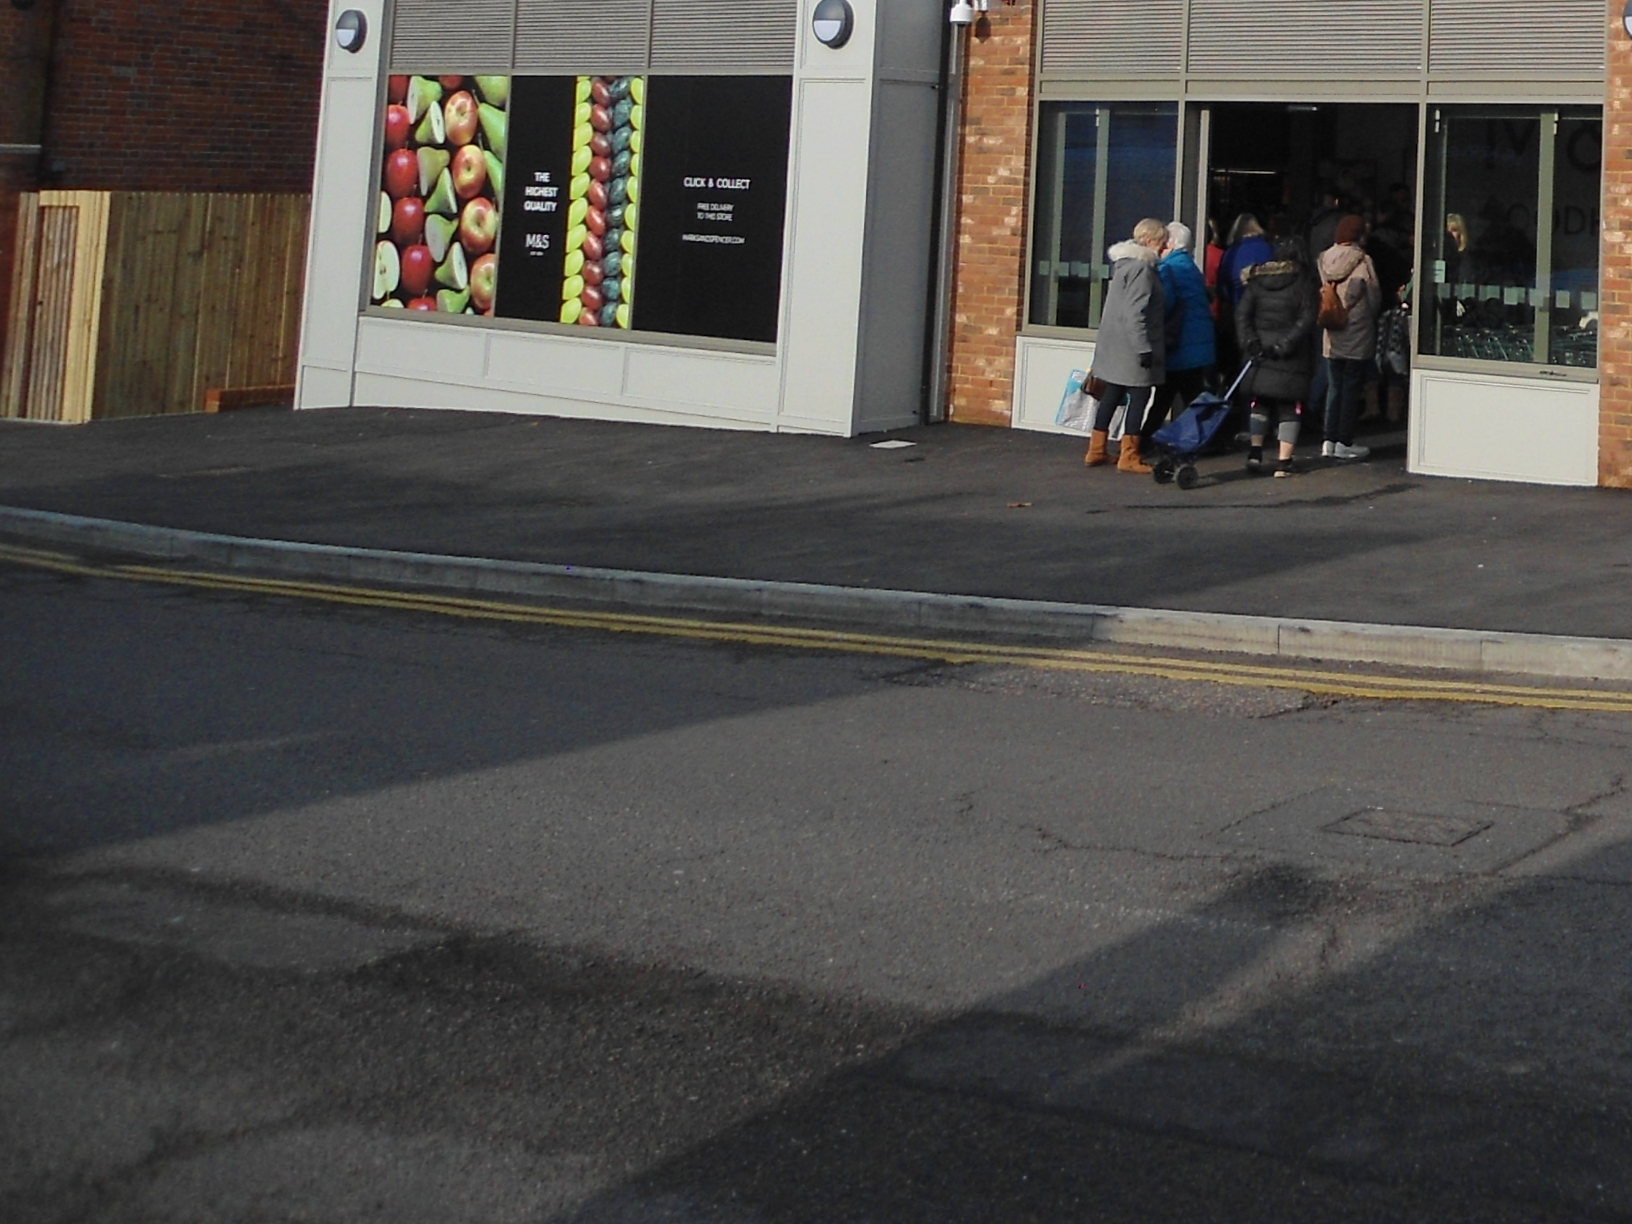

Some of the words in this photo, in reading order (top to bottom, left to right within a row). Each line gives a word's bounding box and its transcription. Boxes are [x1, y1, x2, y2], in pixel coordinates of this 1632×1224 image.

[533, 171, 551, 183] THE
[683, 176, 707, 188] CLICK
[716, 178, 751, 190] COLLECT
[524, 185, 559, 197] HIGHEST
[523, 200, 558, 212] QUALITY
[525, 233, 550, 249] M&S
